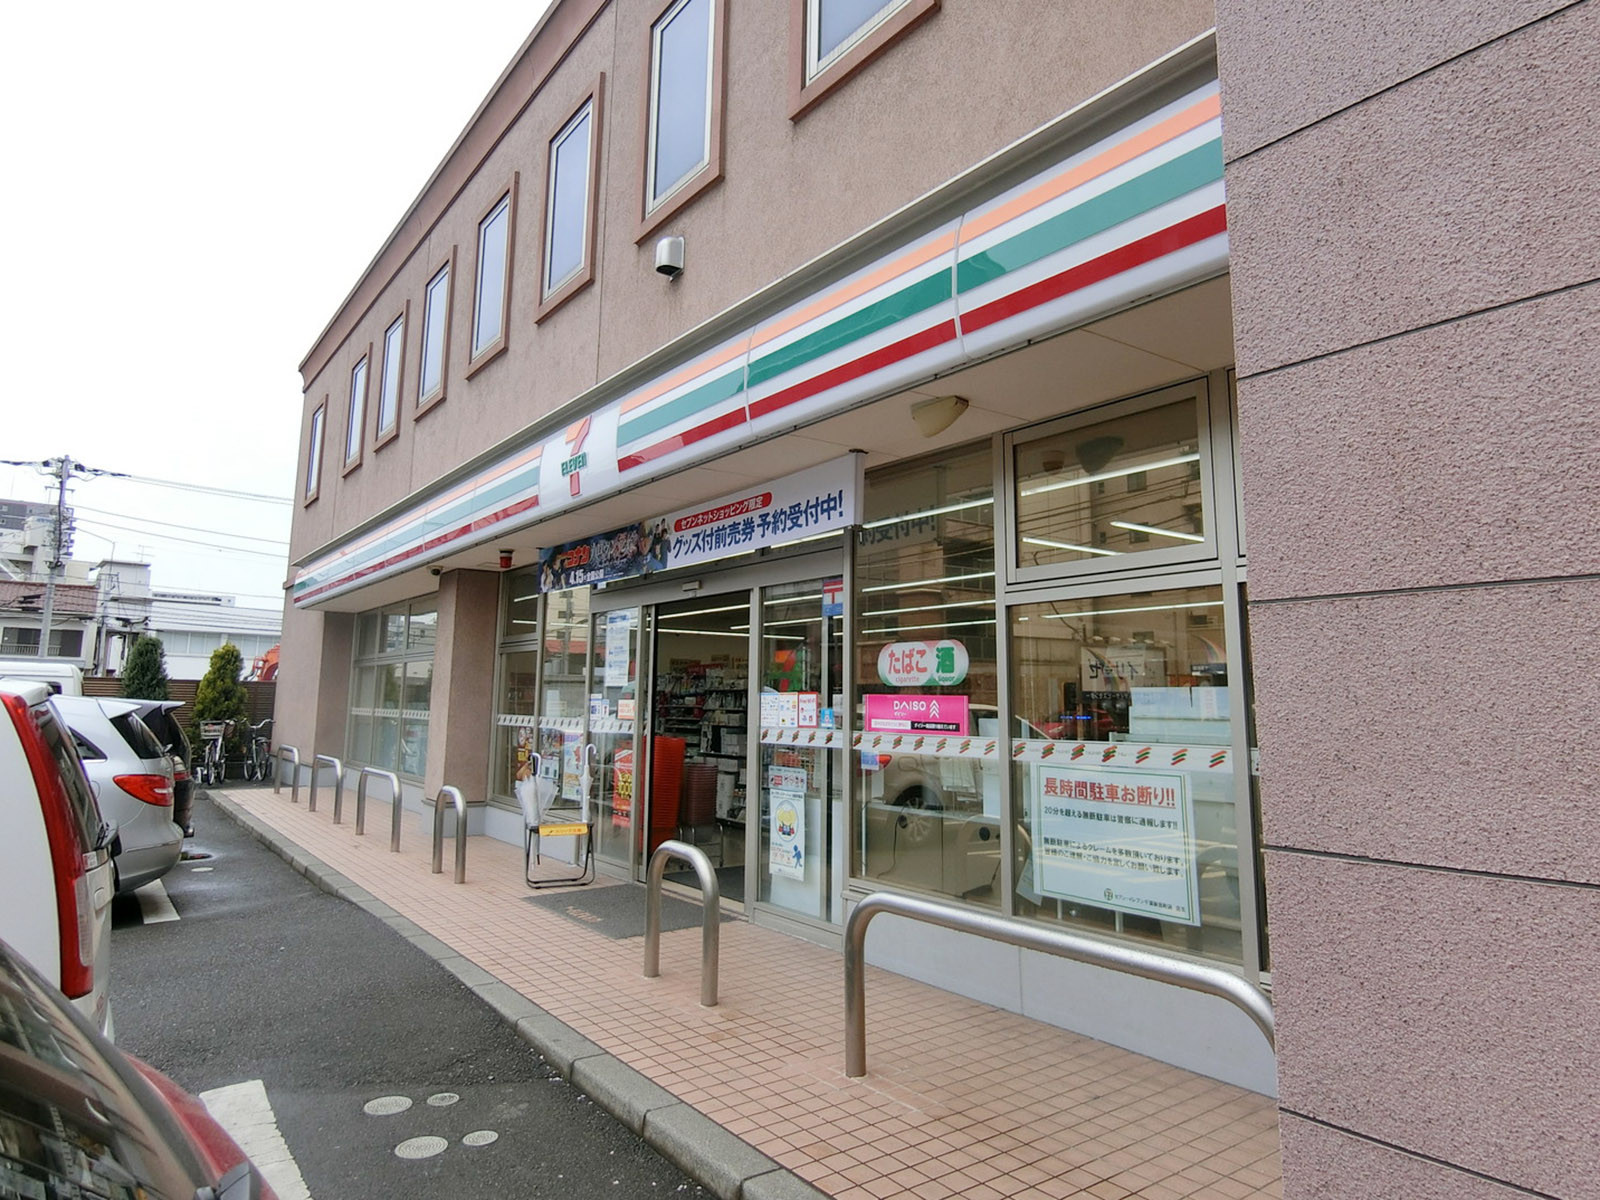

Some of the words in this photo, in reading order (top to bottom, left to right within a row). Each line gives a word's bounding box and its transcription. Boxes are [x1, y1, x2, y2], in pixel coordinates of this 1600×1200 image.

[680, 496, 764, 529] セブンネットショッピング限定
[888, 648, 929, 675] たばこ
[935, 646, 955, 674] 酒
[895, 676, 921, 684] cigarette
[893, 700, 927, 712] DAISO
[1043, 776, 1176, 807] 長時間駐車お断り!!
